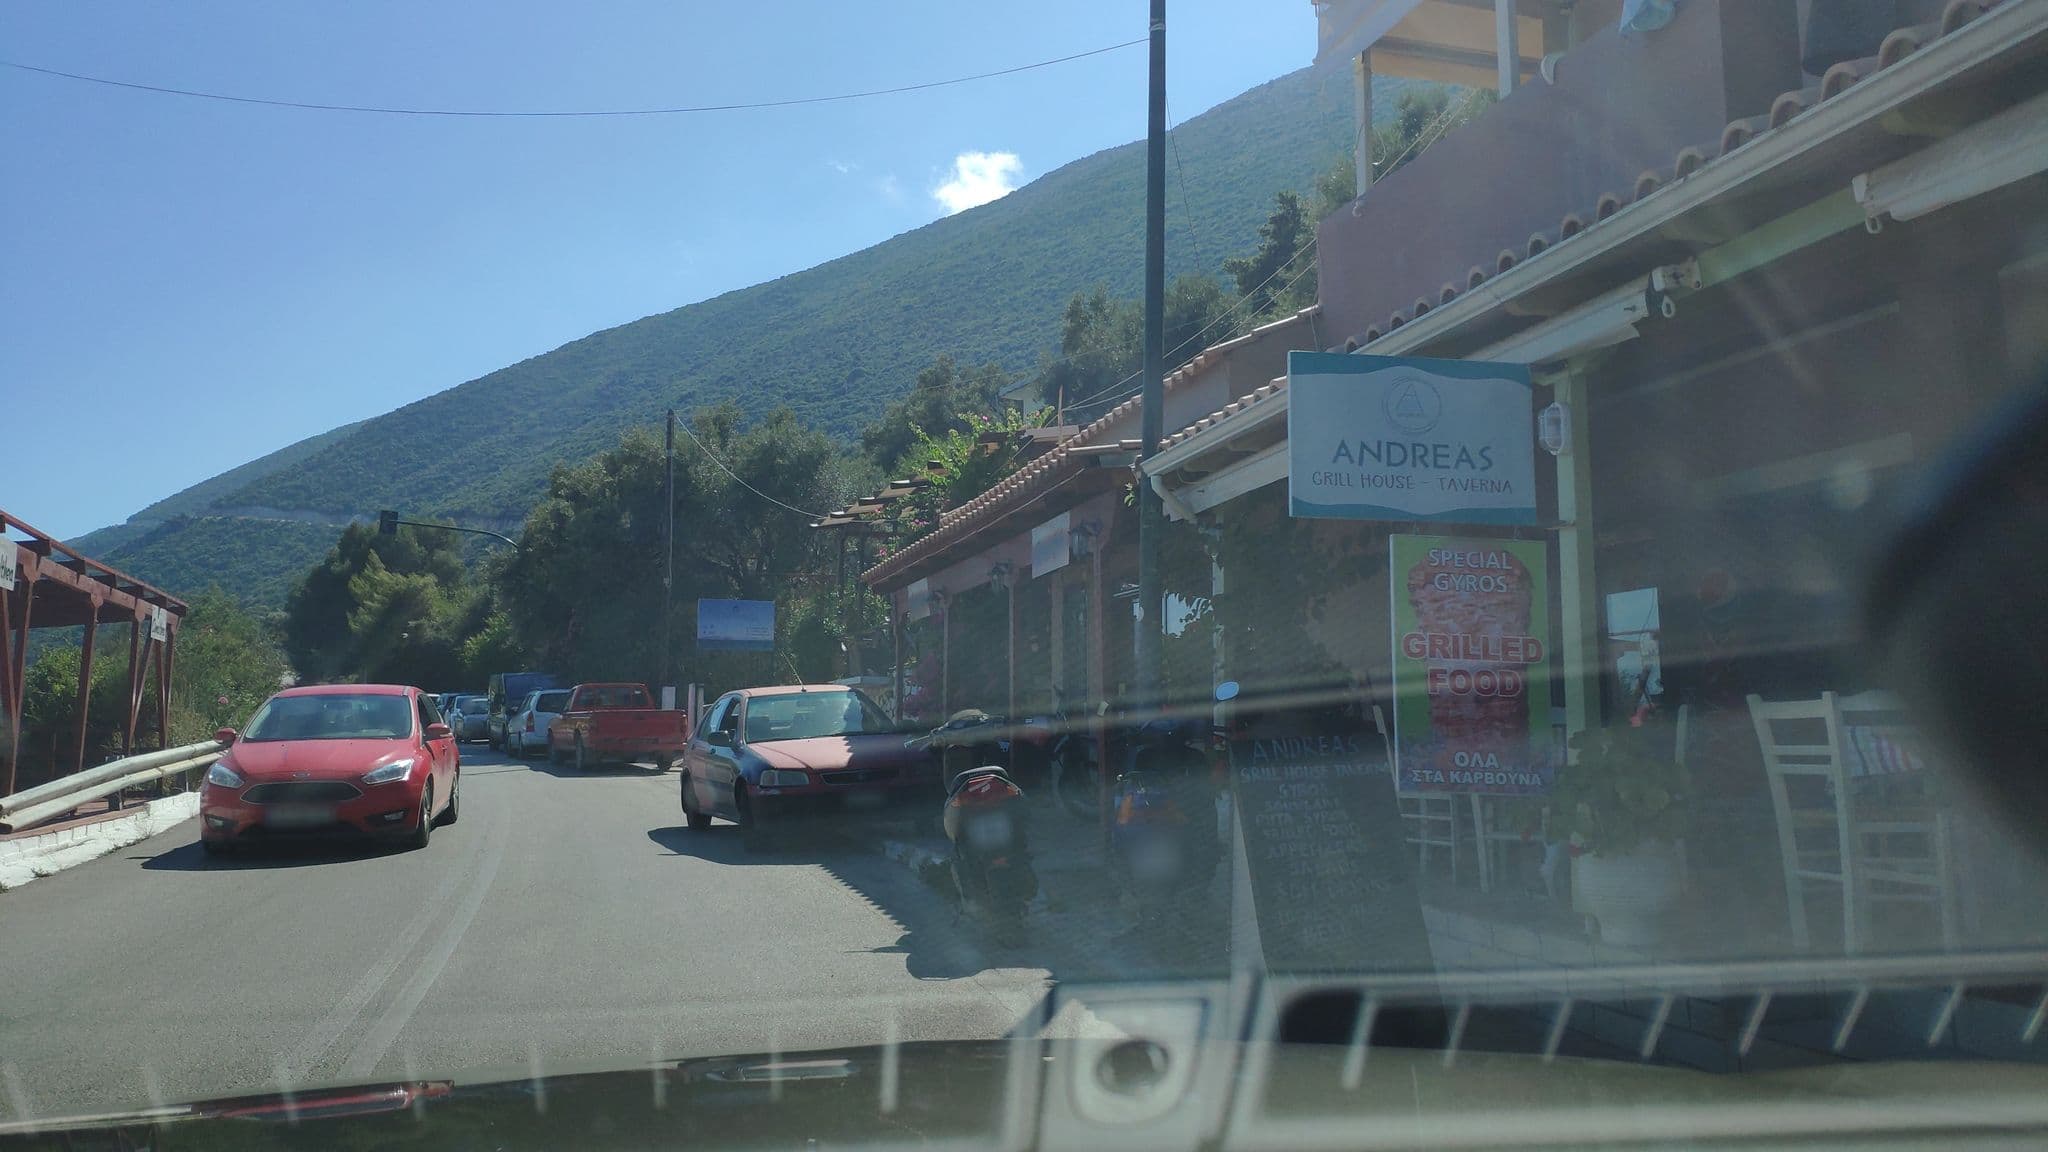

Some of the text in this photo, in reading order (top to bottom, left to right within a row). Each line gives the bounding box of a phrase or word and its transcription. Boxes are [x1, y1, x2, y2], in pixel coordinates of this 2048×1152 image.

[1332, 440, 1493, 472] ANDREAS
[1312, 472, 1353, 488] GRILL
[1360, 474, 1416, 490] HOUSE
[1437, 477, 1513, 494] TAVERNA
[1428, 549, 1513, 570] SPECIAL
[1434, 573, 1508, 593] GYROS
[1402, 632, 1544, 664] GRILLED
[1427, 668, 1521, 698] FOOD
[1253, 735, 1360, 765] ANDREAS
[1454, 751, 1500, 769] ΟΛΑ
[1411, 769, 1543, 786] ΣΤΑ ΚΑΡΒΟΥΝΑ
